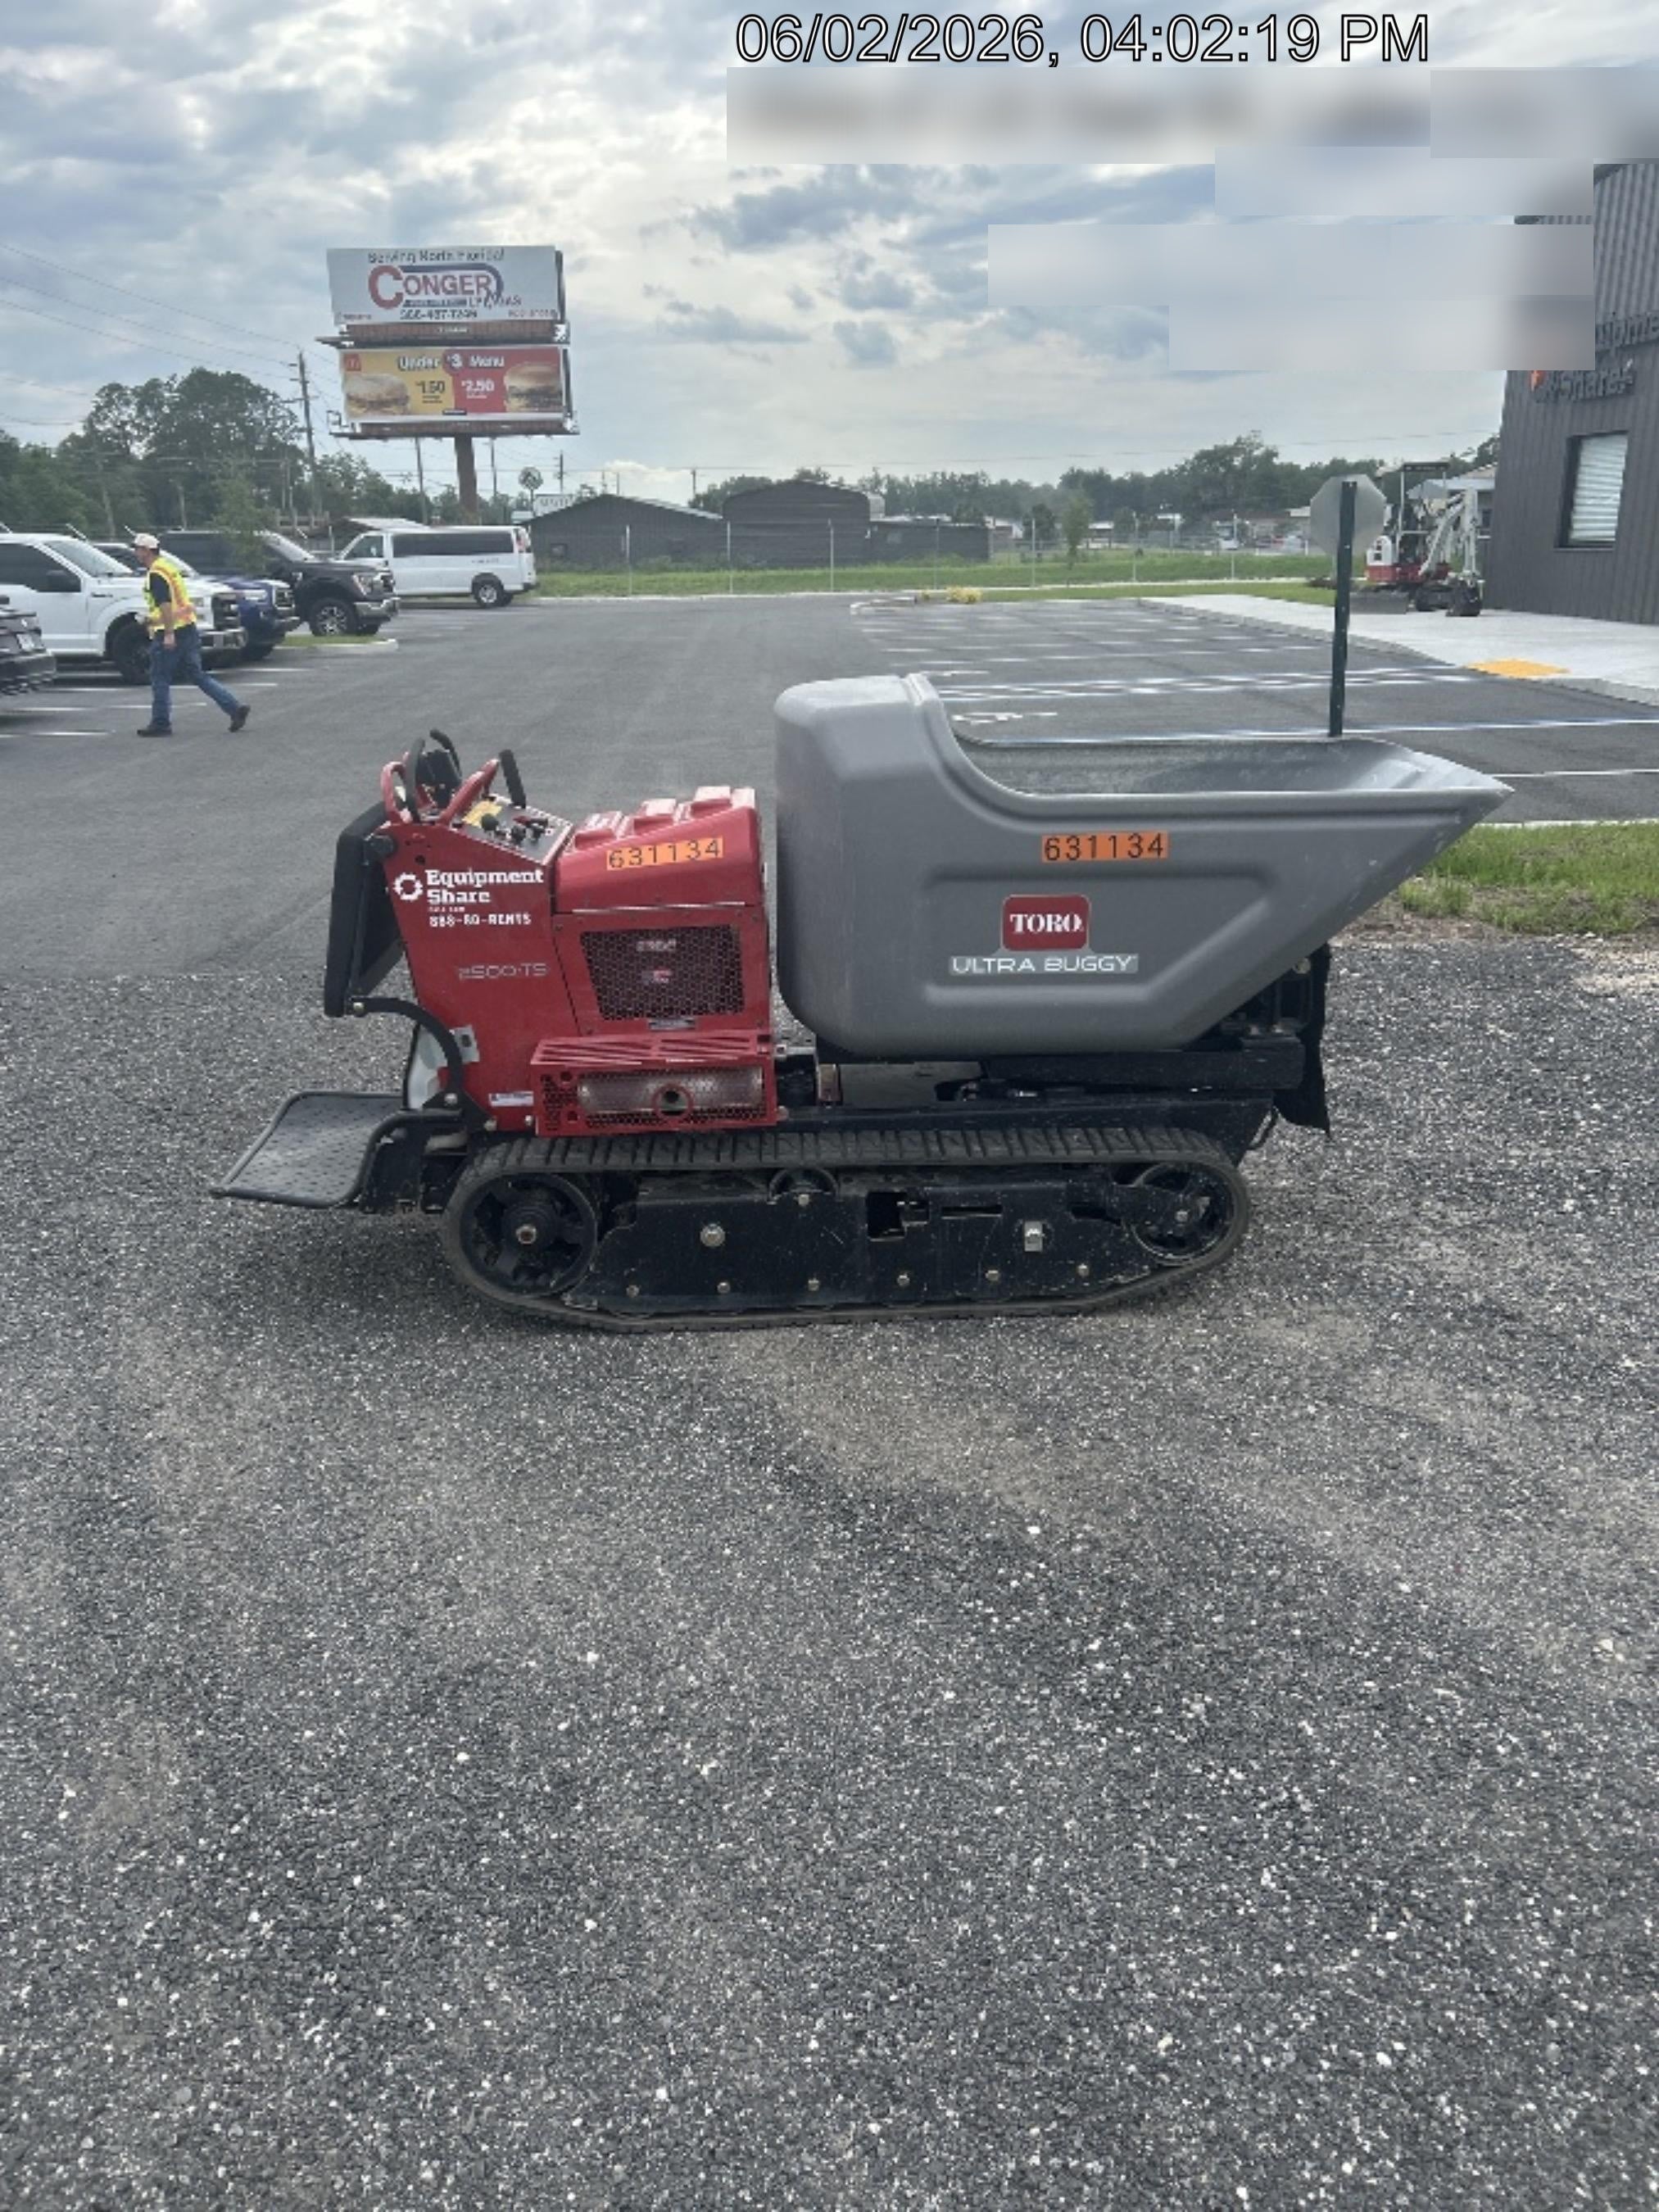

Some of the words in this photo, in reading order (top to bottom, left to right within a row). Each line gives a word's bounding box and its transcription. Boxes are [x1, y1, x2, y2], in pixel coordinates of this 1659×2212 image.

[368, 265, 496, 310] CONGER
[398, 355, 441, 371] Under
[609, 839, 719, 869] 631134
[1043, 832, 1164, 861] 631134
[425, 868, 544, 888] Equipment
[427, 888, 491, 904] Share
[1009, 913, 1083, 933] TORO
[952, 957, 1036, 975] ULTRA
[1044, 954, 1134, 972] BUGGY
